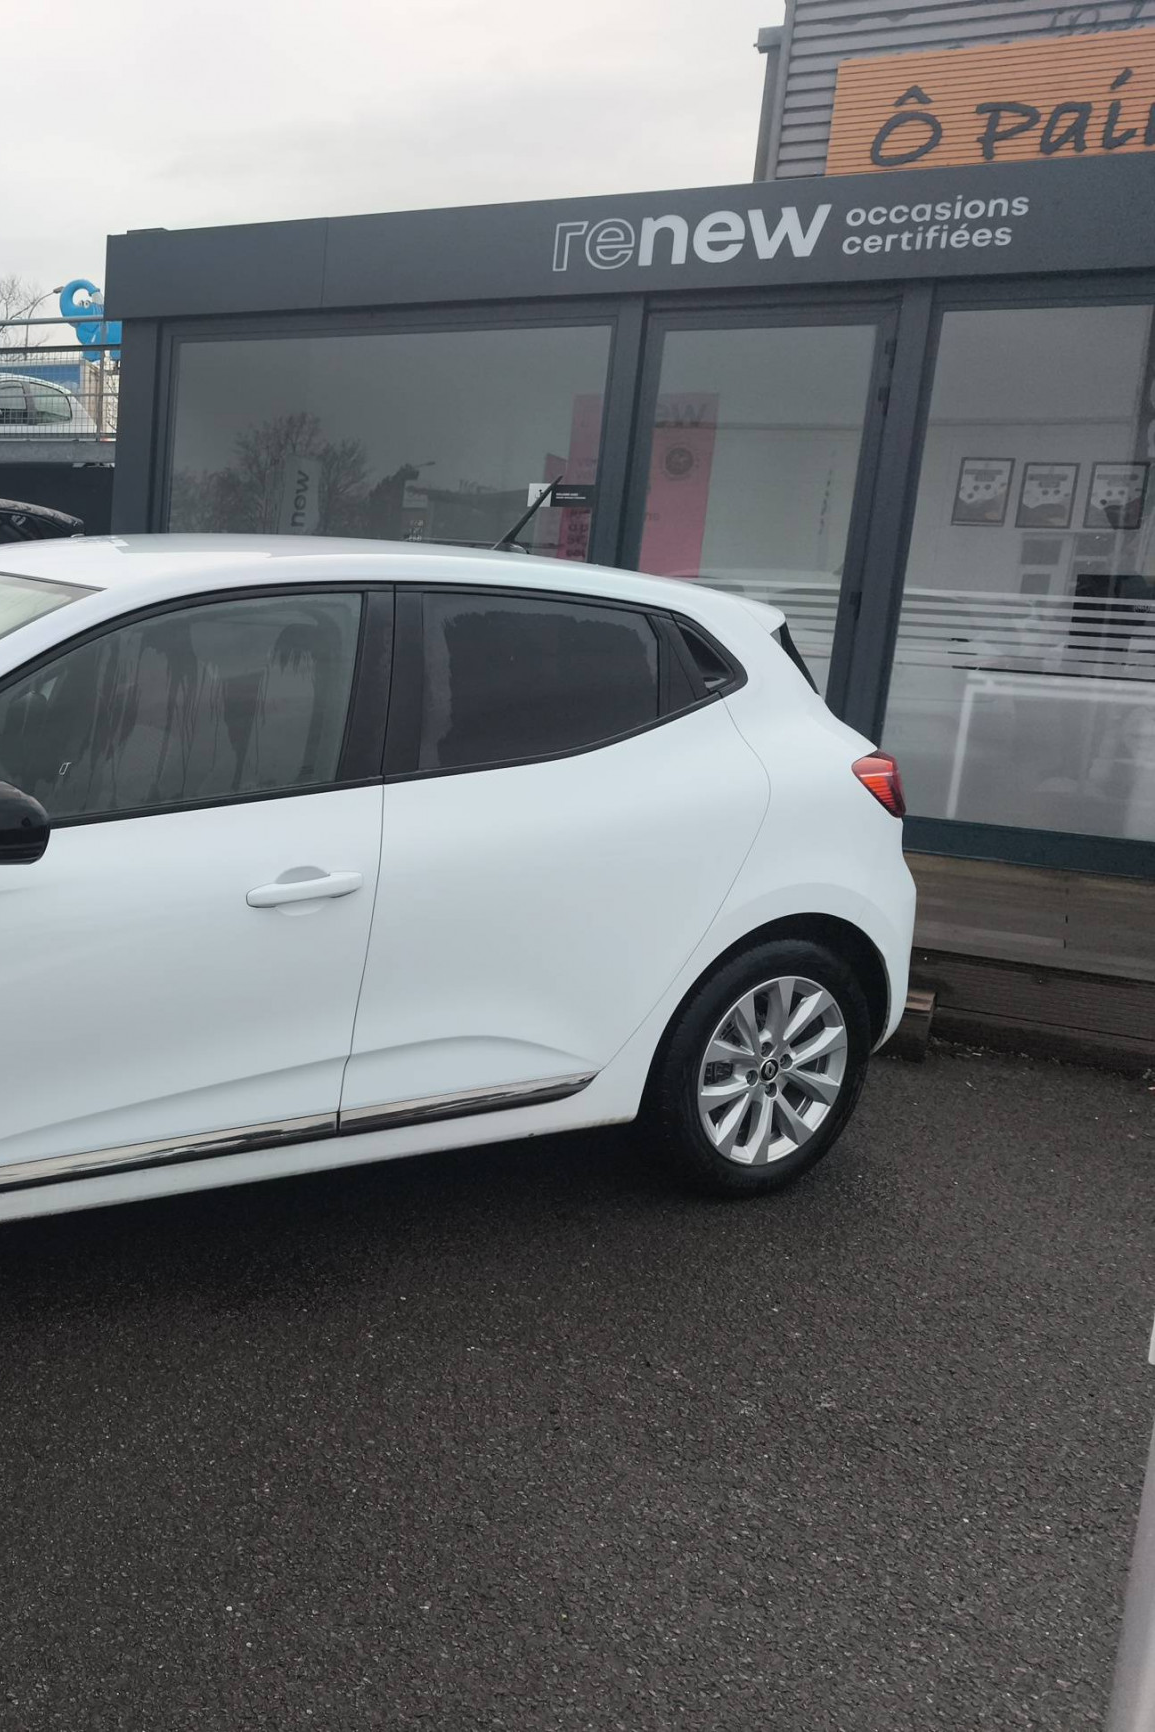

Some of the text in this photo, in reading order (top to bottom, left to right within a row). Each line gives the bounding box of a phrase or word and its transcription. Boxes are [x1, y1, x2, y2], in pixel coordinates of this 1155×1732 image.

[845, 195, 1030, 227] occasions
[552, 203, 832, 272] renew
[841, 223, 1013, 256] certifiées
